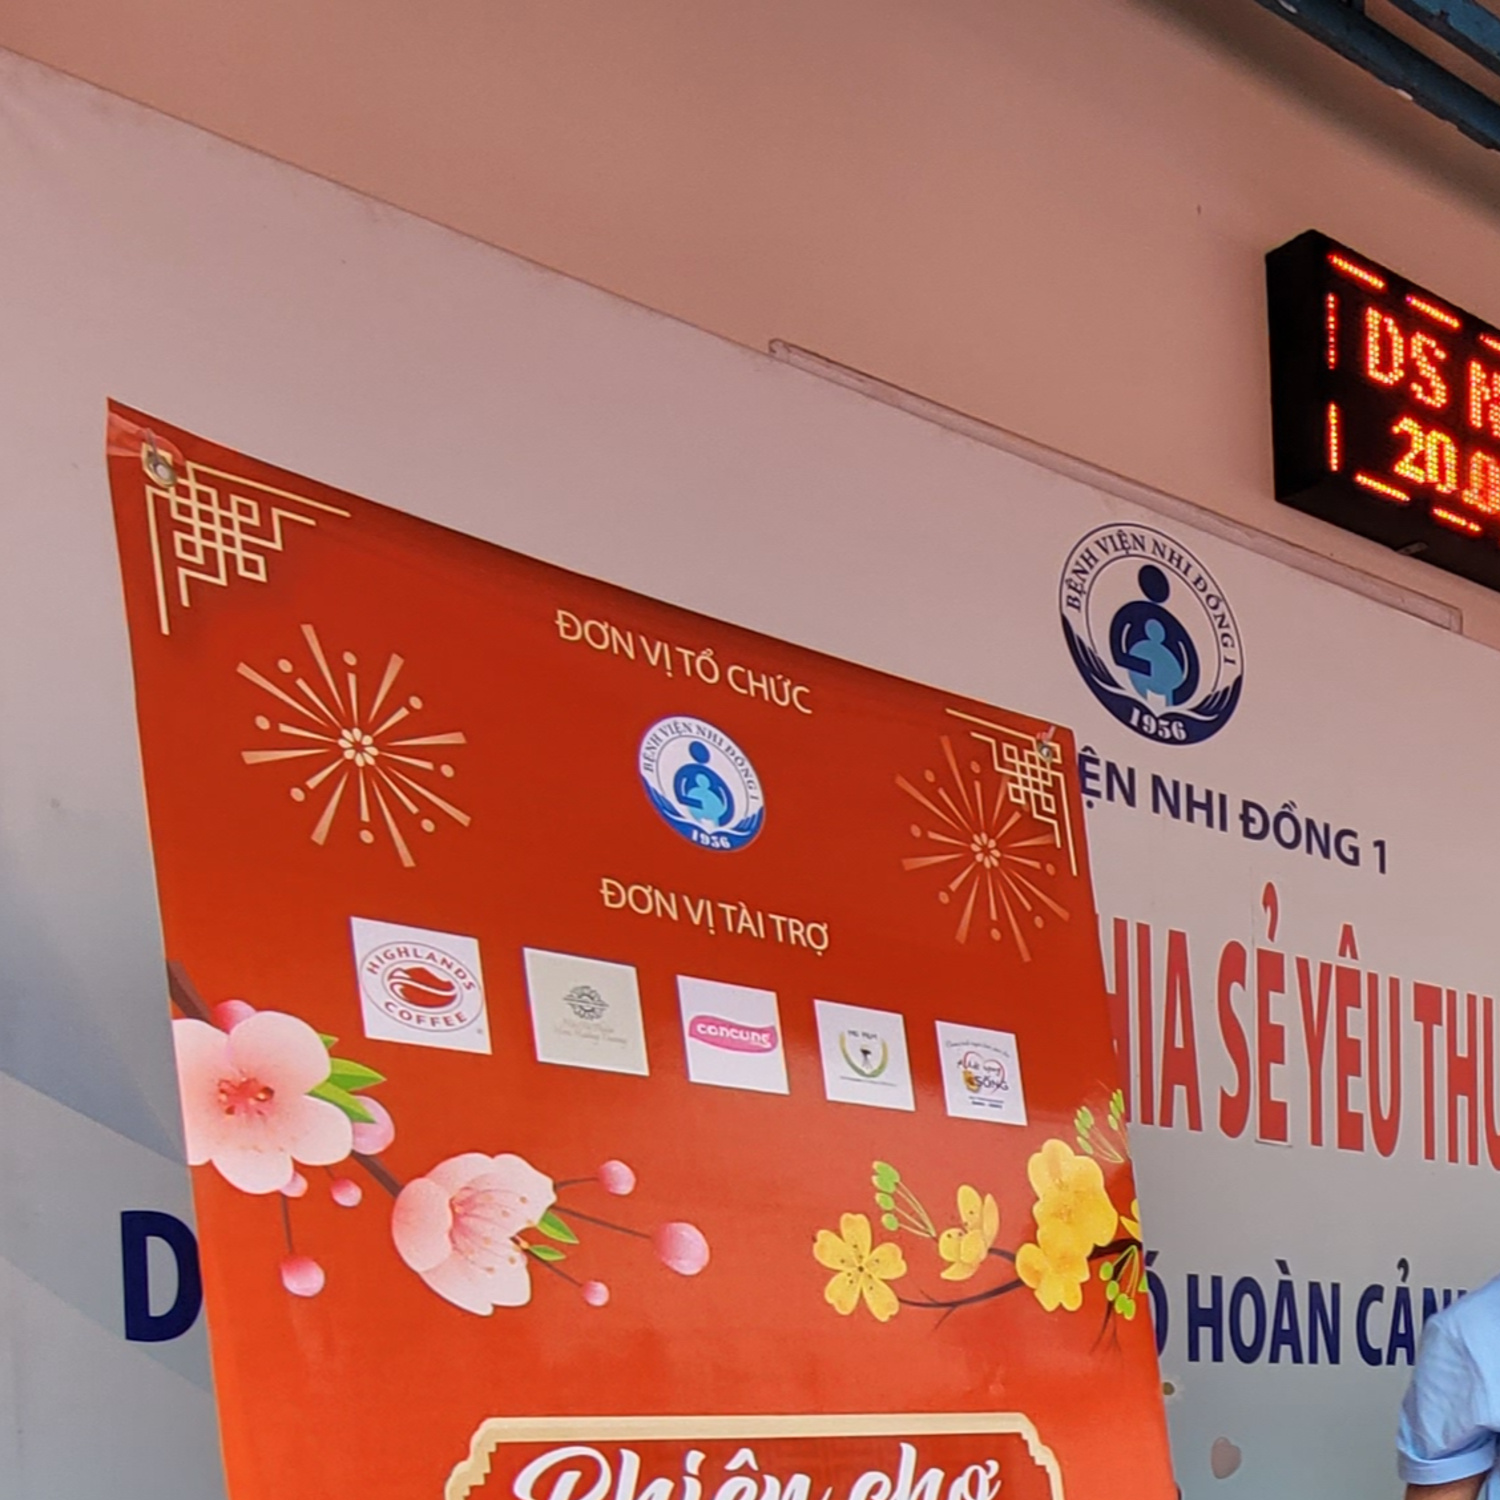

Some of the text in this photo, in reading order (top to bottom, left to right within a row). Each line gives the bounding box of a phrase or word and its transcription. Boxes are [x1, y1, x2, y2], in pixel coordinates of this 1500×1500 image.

[1366, 307, 1447, 408] DS
[1151, 537, 1193, 577] NHI
[555, 609, 814, 714] ĐƠN VỊ TỔ CHỨC
[1129, 706, 1188, 742] 1956
[1151, 772, 1229, 833] NHI
[1239, 800, 1362, 868] ĐỒNG
[1372, 838, 1388, 875] 1
[600, 877, 830, 957] ĐƠN VỊ TÀI TRỢ
[367, 946, 477, 992] HIGHLANDS
[384, 1000, 468, 1029] COFFEE
[1216, 880, 1290, 1143] SẺ
[1294, 923, 1401, 1158] YÊU
[1185, 1258, 1343, 1365] HOÀN
[1356, 1257, 1468, 1367] CẢ
